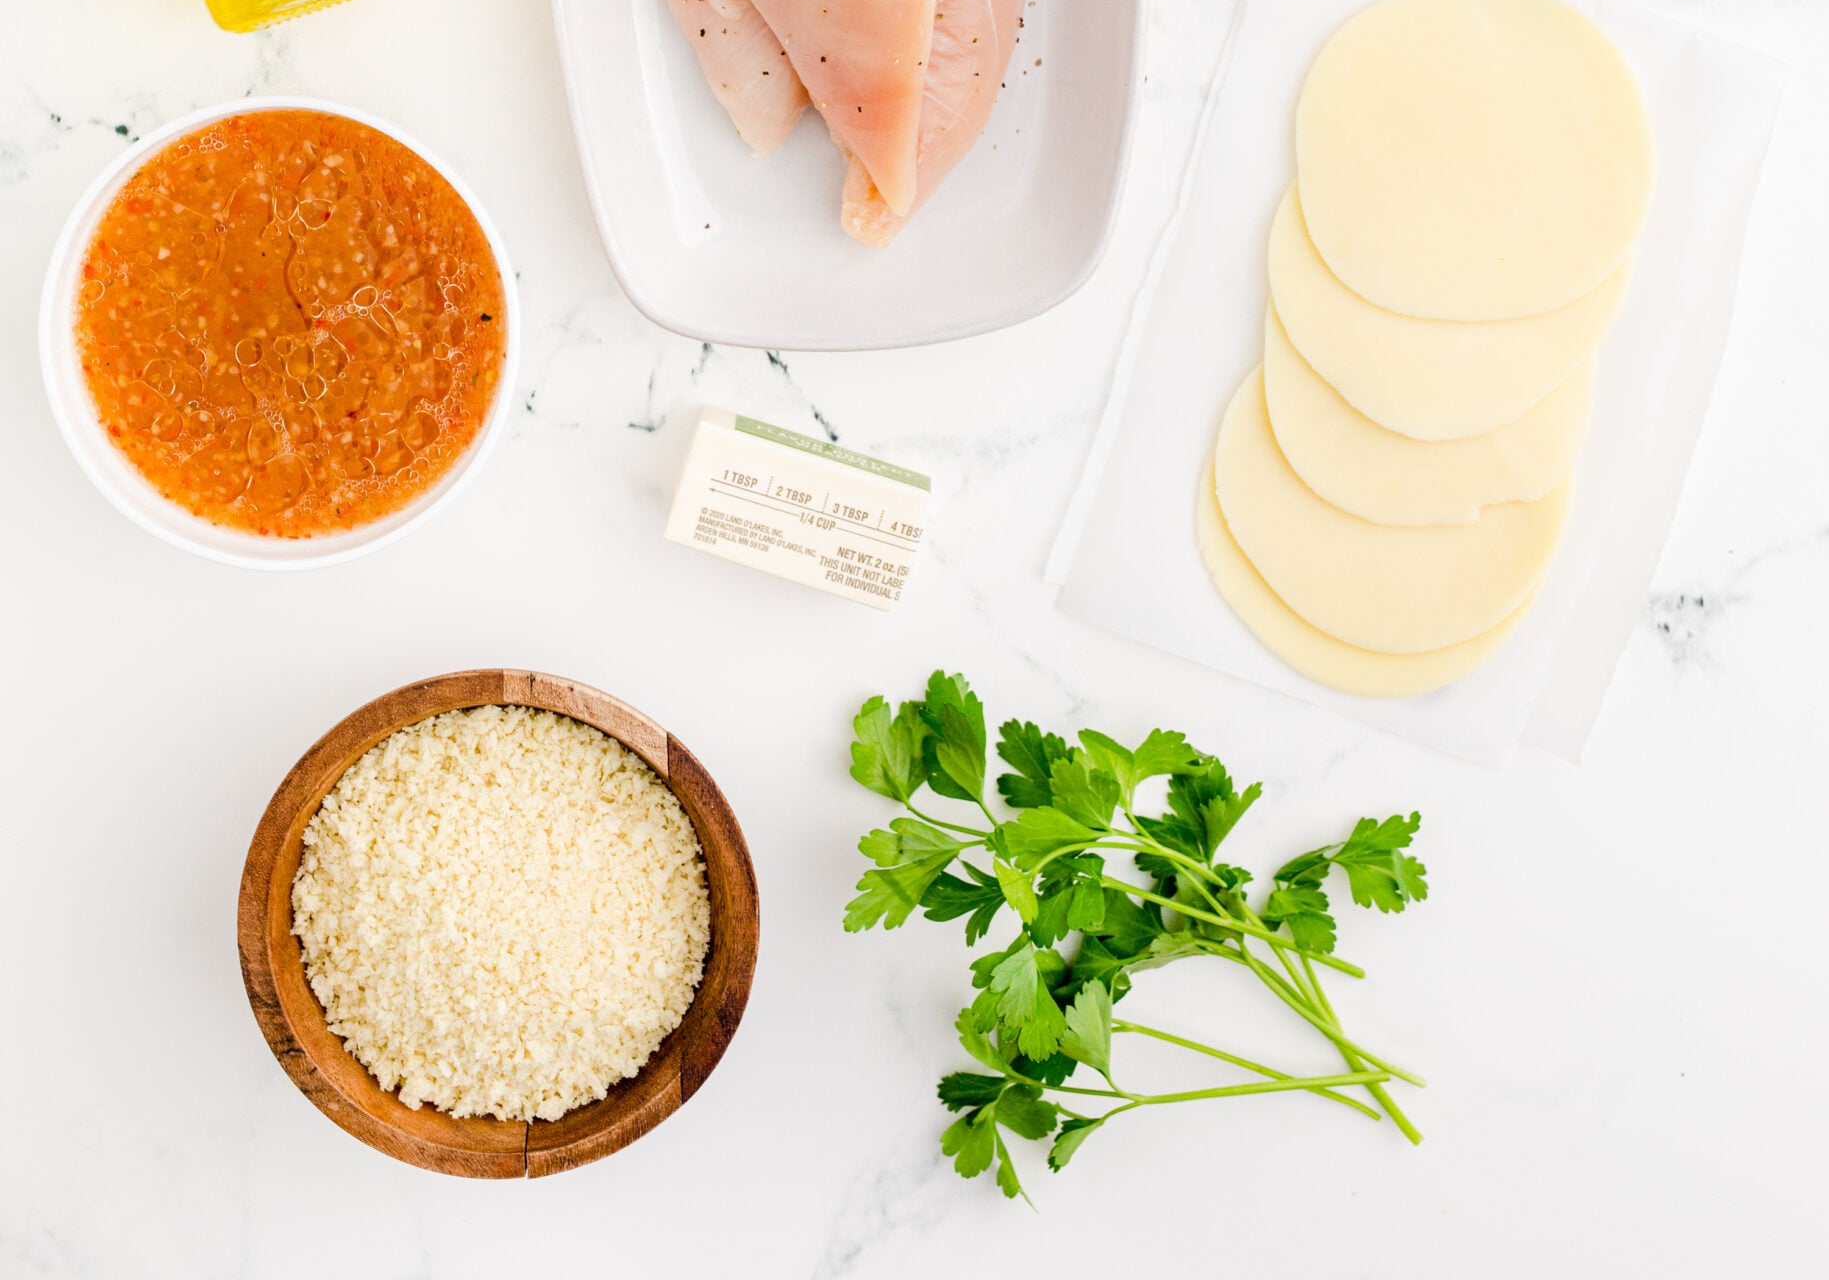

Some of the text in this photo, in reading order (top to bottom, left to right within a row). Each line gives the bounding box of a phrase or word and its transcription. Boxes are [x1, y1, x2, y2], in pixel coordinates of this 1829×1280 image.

[723, 469, 758, 488] 1 TBSP
[776, 486, 812, 505] 2 TBSP
[799, 512, 836, 531] 1/4 CUP
[832, 503, 869, 522] 3 TBSP
[695, 524, 717, 537] ARDEN
[739, 537, 749, 546] MN
[698, 515, 749, 535] MANUFACTURED
[749, 529, 758, 538] BY
[758, 533, 776, 544] LAND
[804, 547, 817, 557] INC.
[725, 514, 743, 525] LAND
[771, 528, 784, 538] INC.
[890, 521, 898, 532] 4
[837, 546, 857, 561] NET
[857, 552, 873, 567] WT.
[874, 558, 882, 569] 2
[882, 563, 896, 574] oz.
[819, 556, 905, 590] THIS UNIT NOT LABE
[825, 570, 844, 584] FOR
[845, 576, 892, 599] INDIVIDUAL
